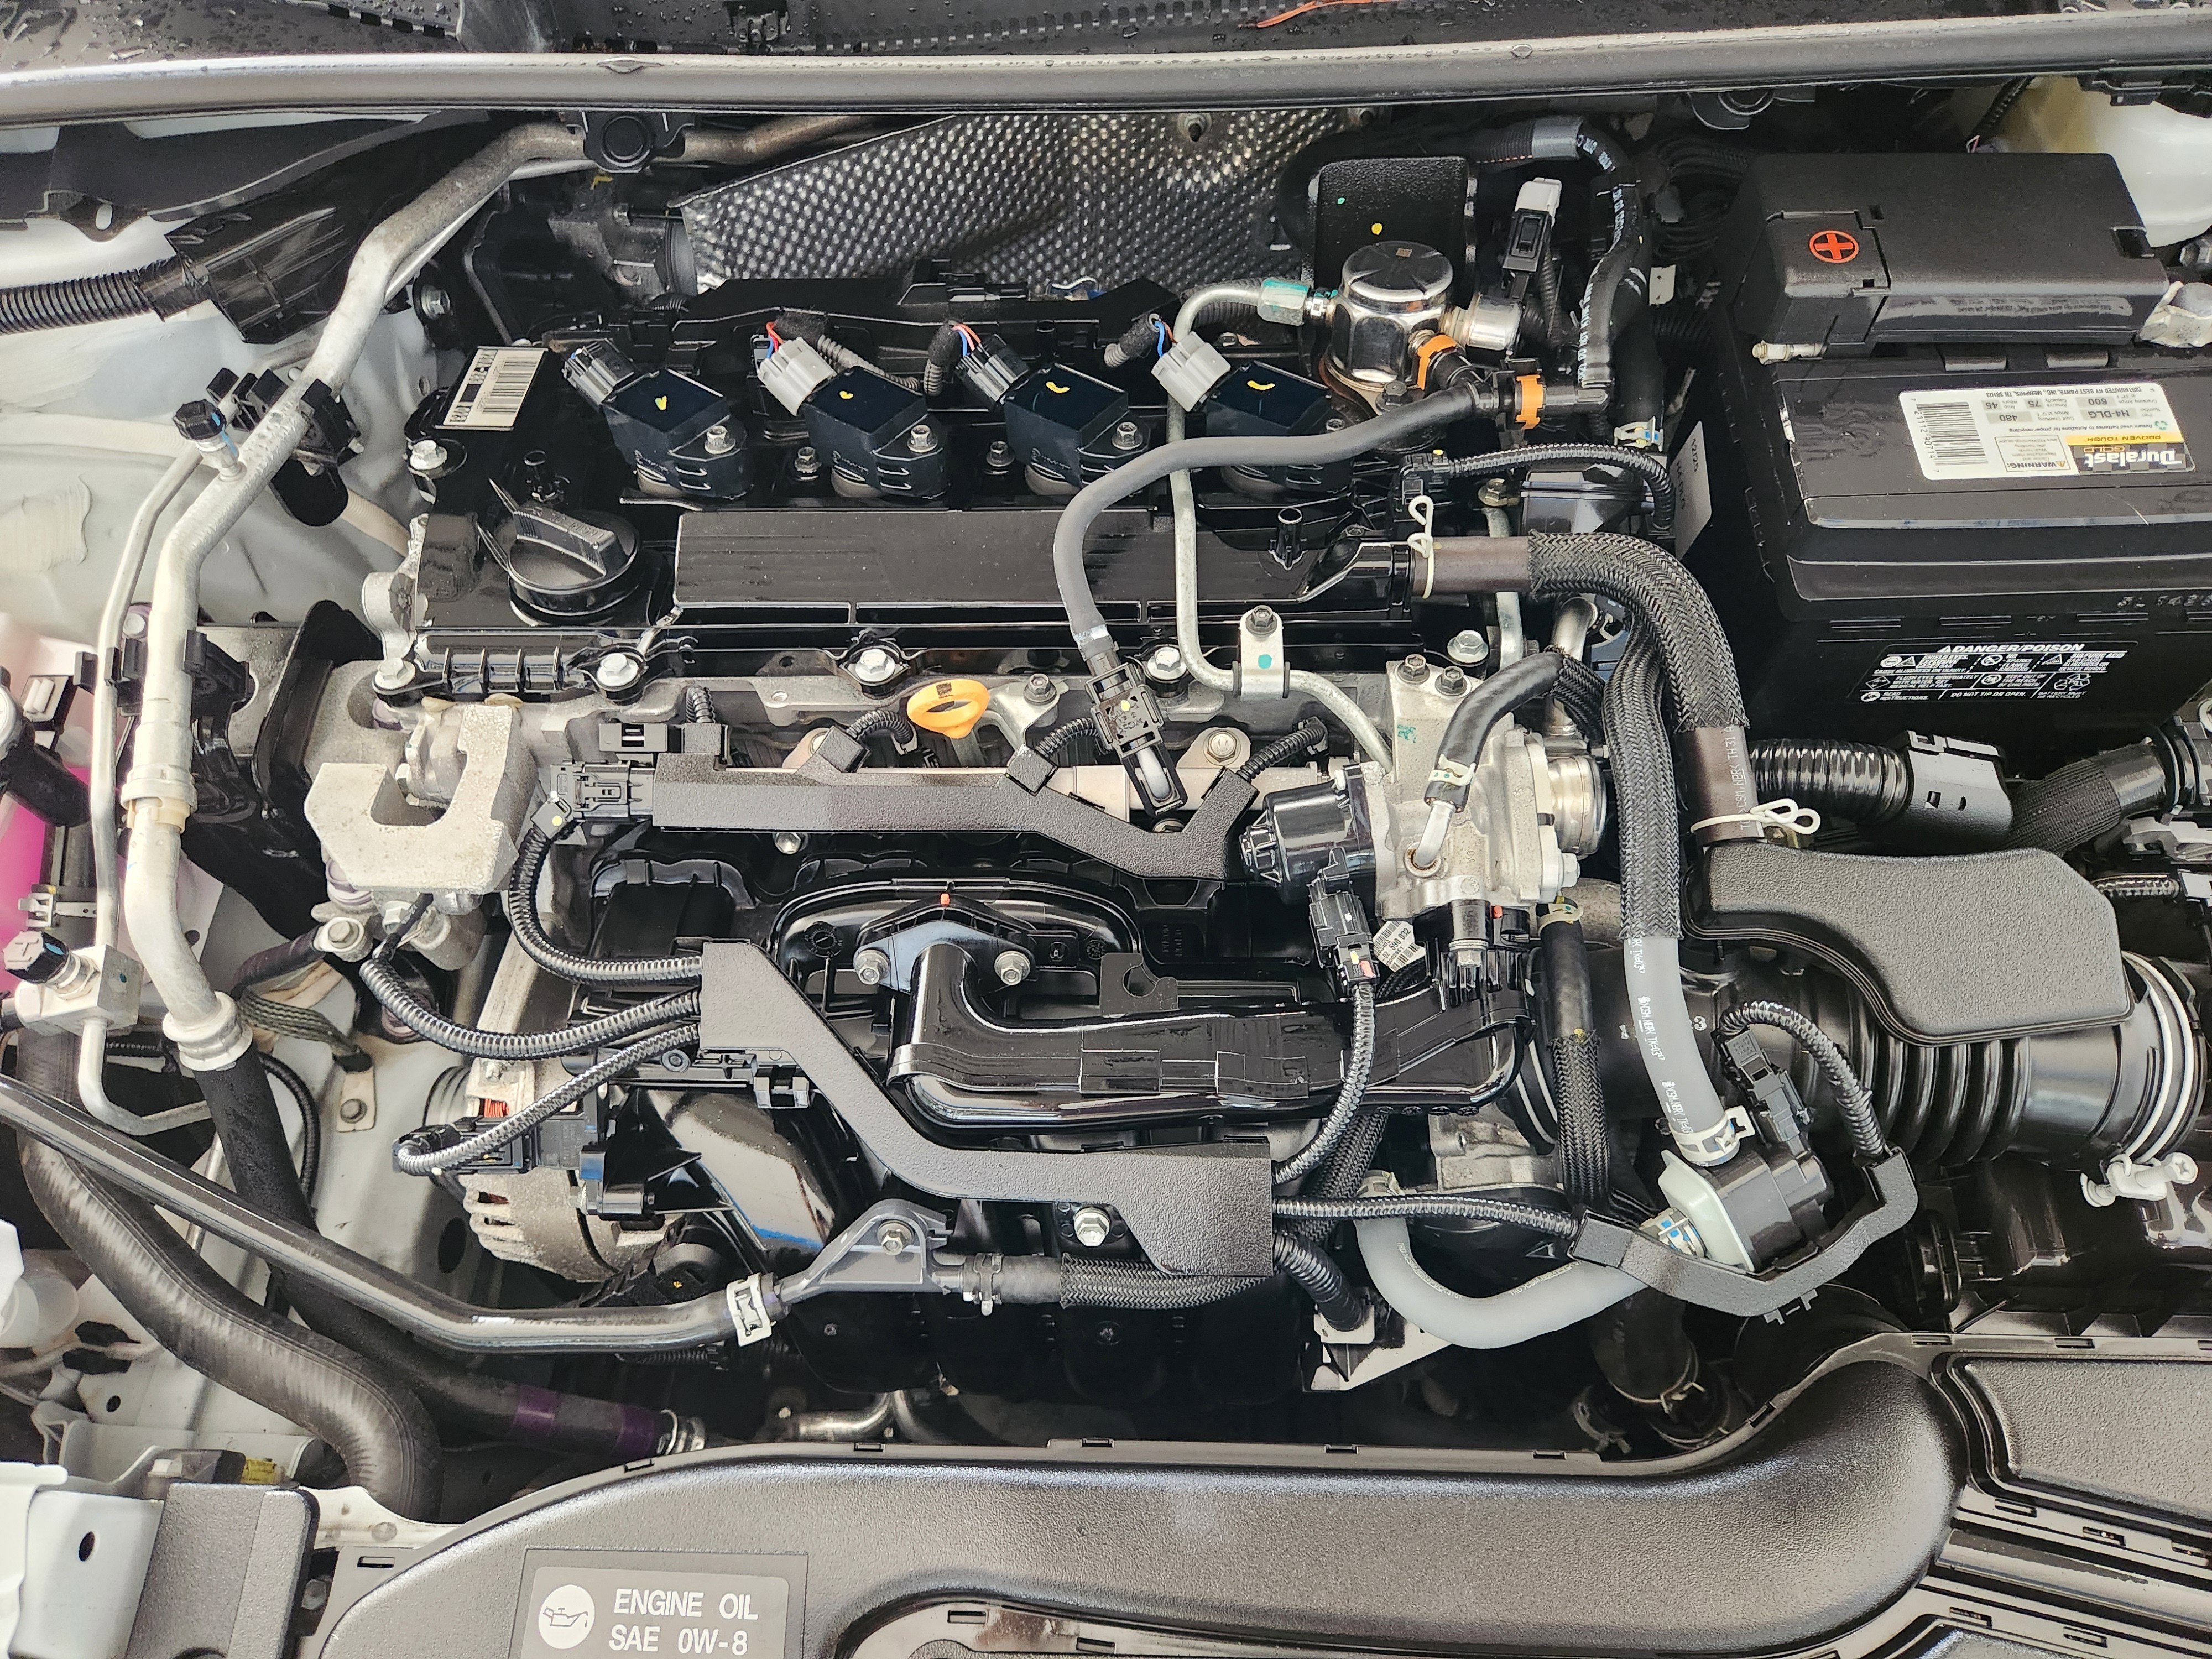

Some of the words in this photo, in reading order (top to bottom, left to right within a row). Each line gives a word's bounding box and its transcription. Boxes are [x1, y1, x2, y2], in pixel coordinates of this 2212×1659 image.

[2088, 410, 2130, 419] H4-DLG
[2084, 450, 2182, 468] Duralast
[1951, 644, 2085, 653] DANGER/POISON
[1389, 938, 1401, 951] 590
[1398, 928, 1411, 940] 032
[613, 1588, 705, 1618] ENGINE
[719, 1592, 759, 1621] OIL
[609, 1624, 661, 1653] SAE
[677, 1627, 749, 1656] 0W-8
